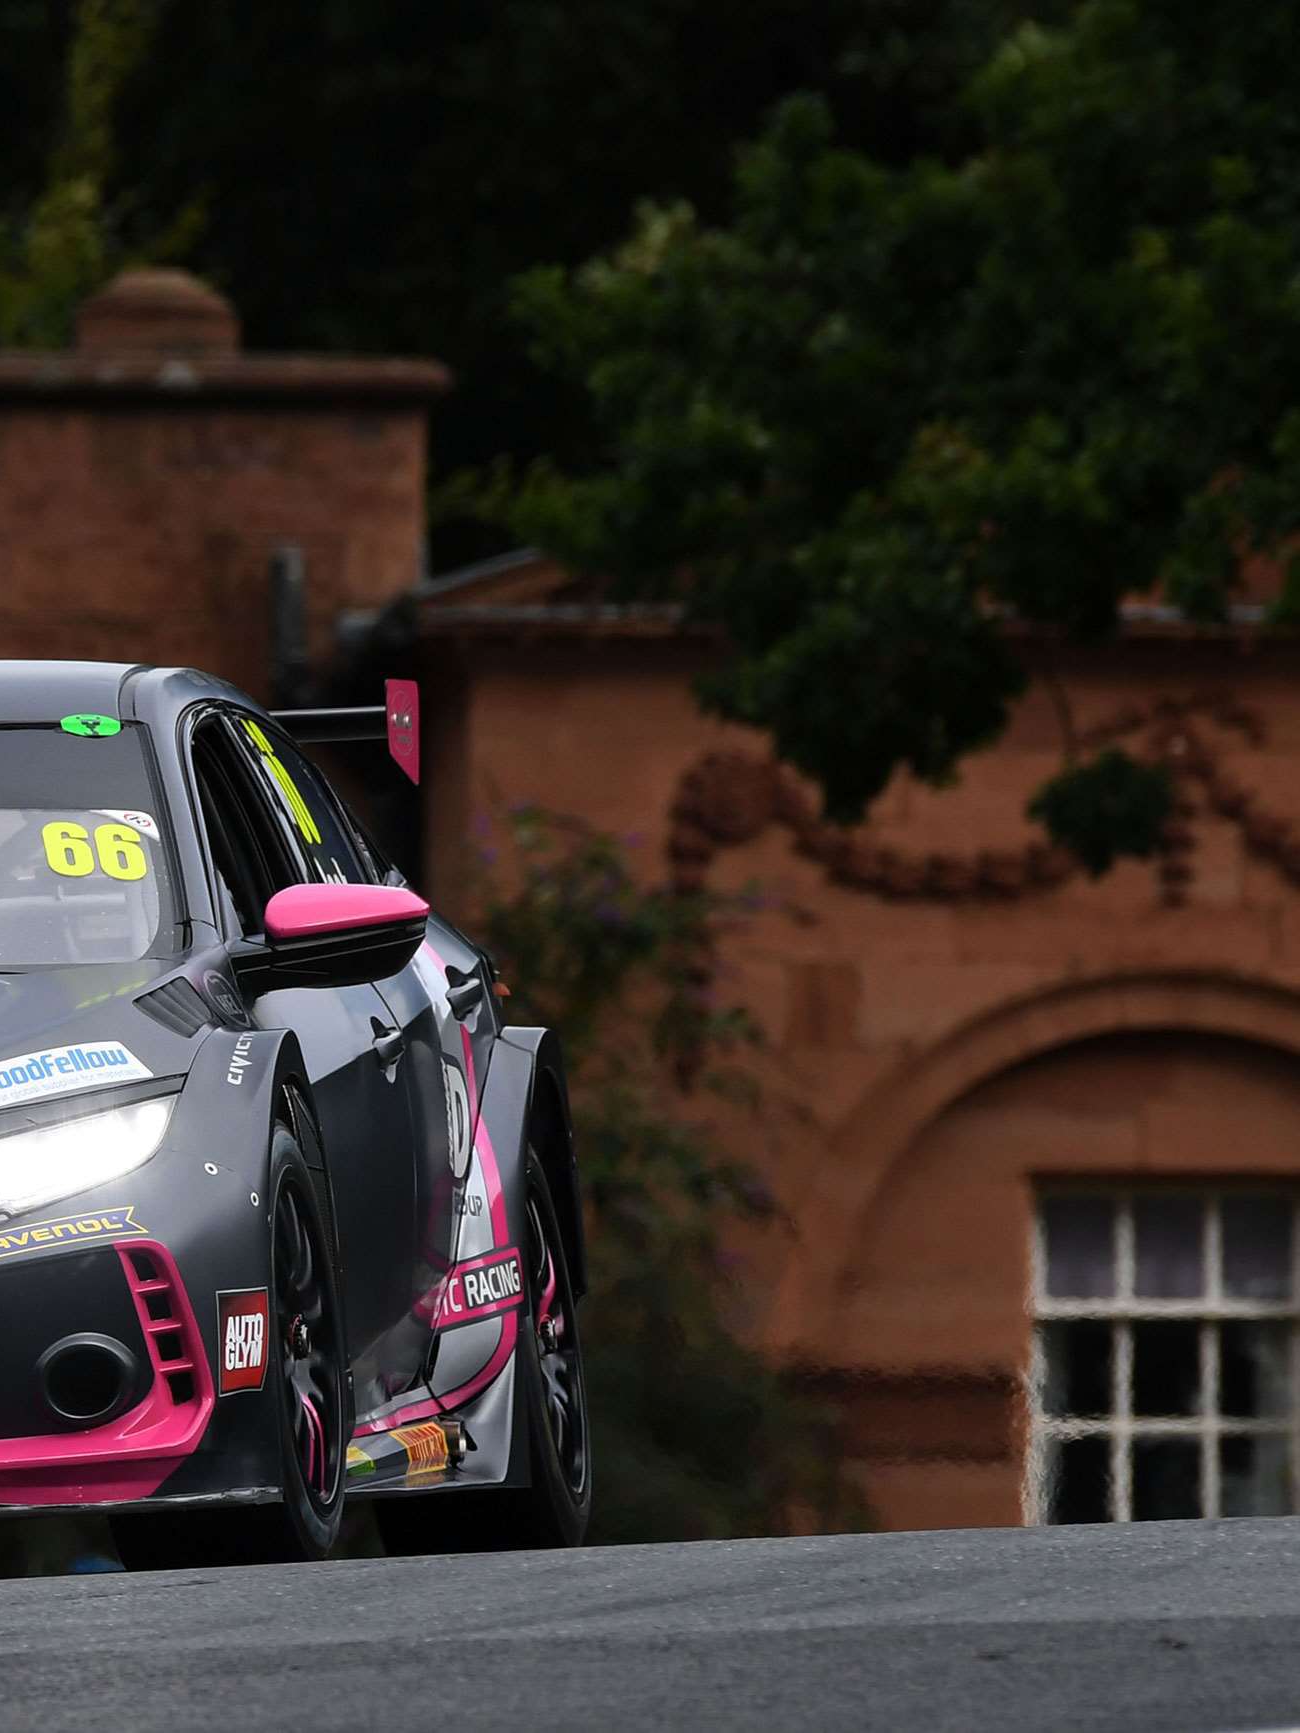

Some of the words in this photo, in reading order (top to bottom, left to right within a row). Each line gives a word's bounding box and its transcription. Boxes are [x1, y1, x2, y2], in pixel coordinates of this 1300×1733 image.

[41, 821, 147, 881] 66
[464, 1260, 521, 1307] RACING
[225, 1312, 264, 1344] AUTO
